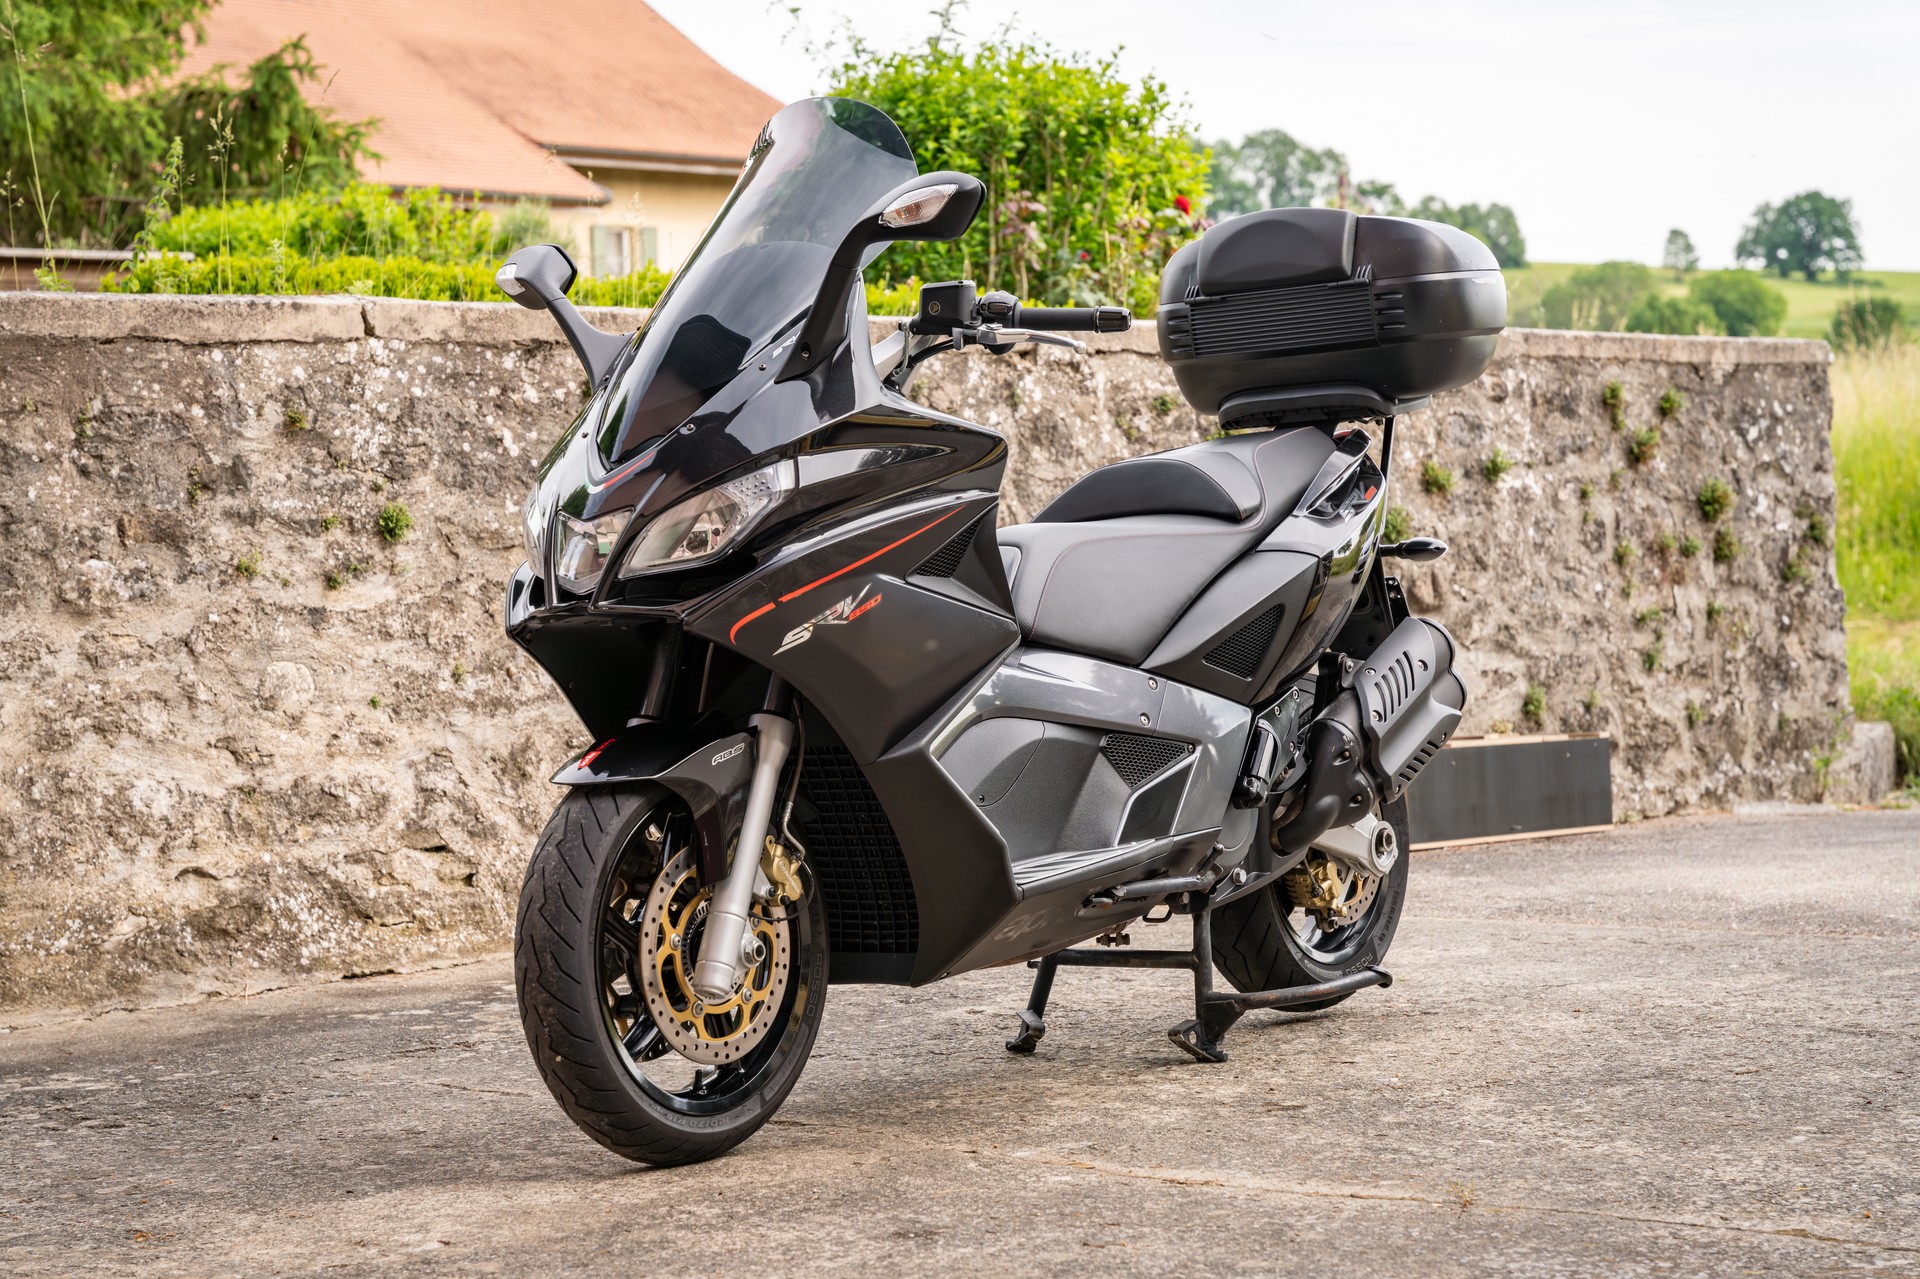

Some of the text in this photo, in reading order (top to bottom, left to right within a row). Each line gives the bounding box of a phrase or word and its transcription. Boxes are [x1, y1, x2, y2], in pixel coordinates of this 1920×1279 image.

[772, 583, 882, 656] SRV 850
[712, 743, 745, 765] ABS
[1346, 953, 1373, 975] ROSSO
[807, 953, 822, 1017] ROSSO
[689, 1116, 729, 1128] 120/70
